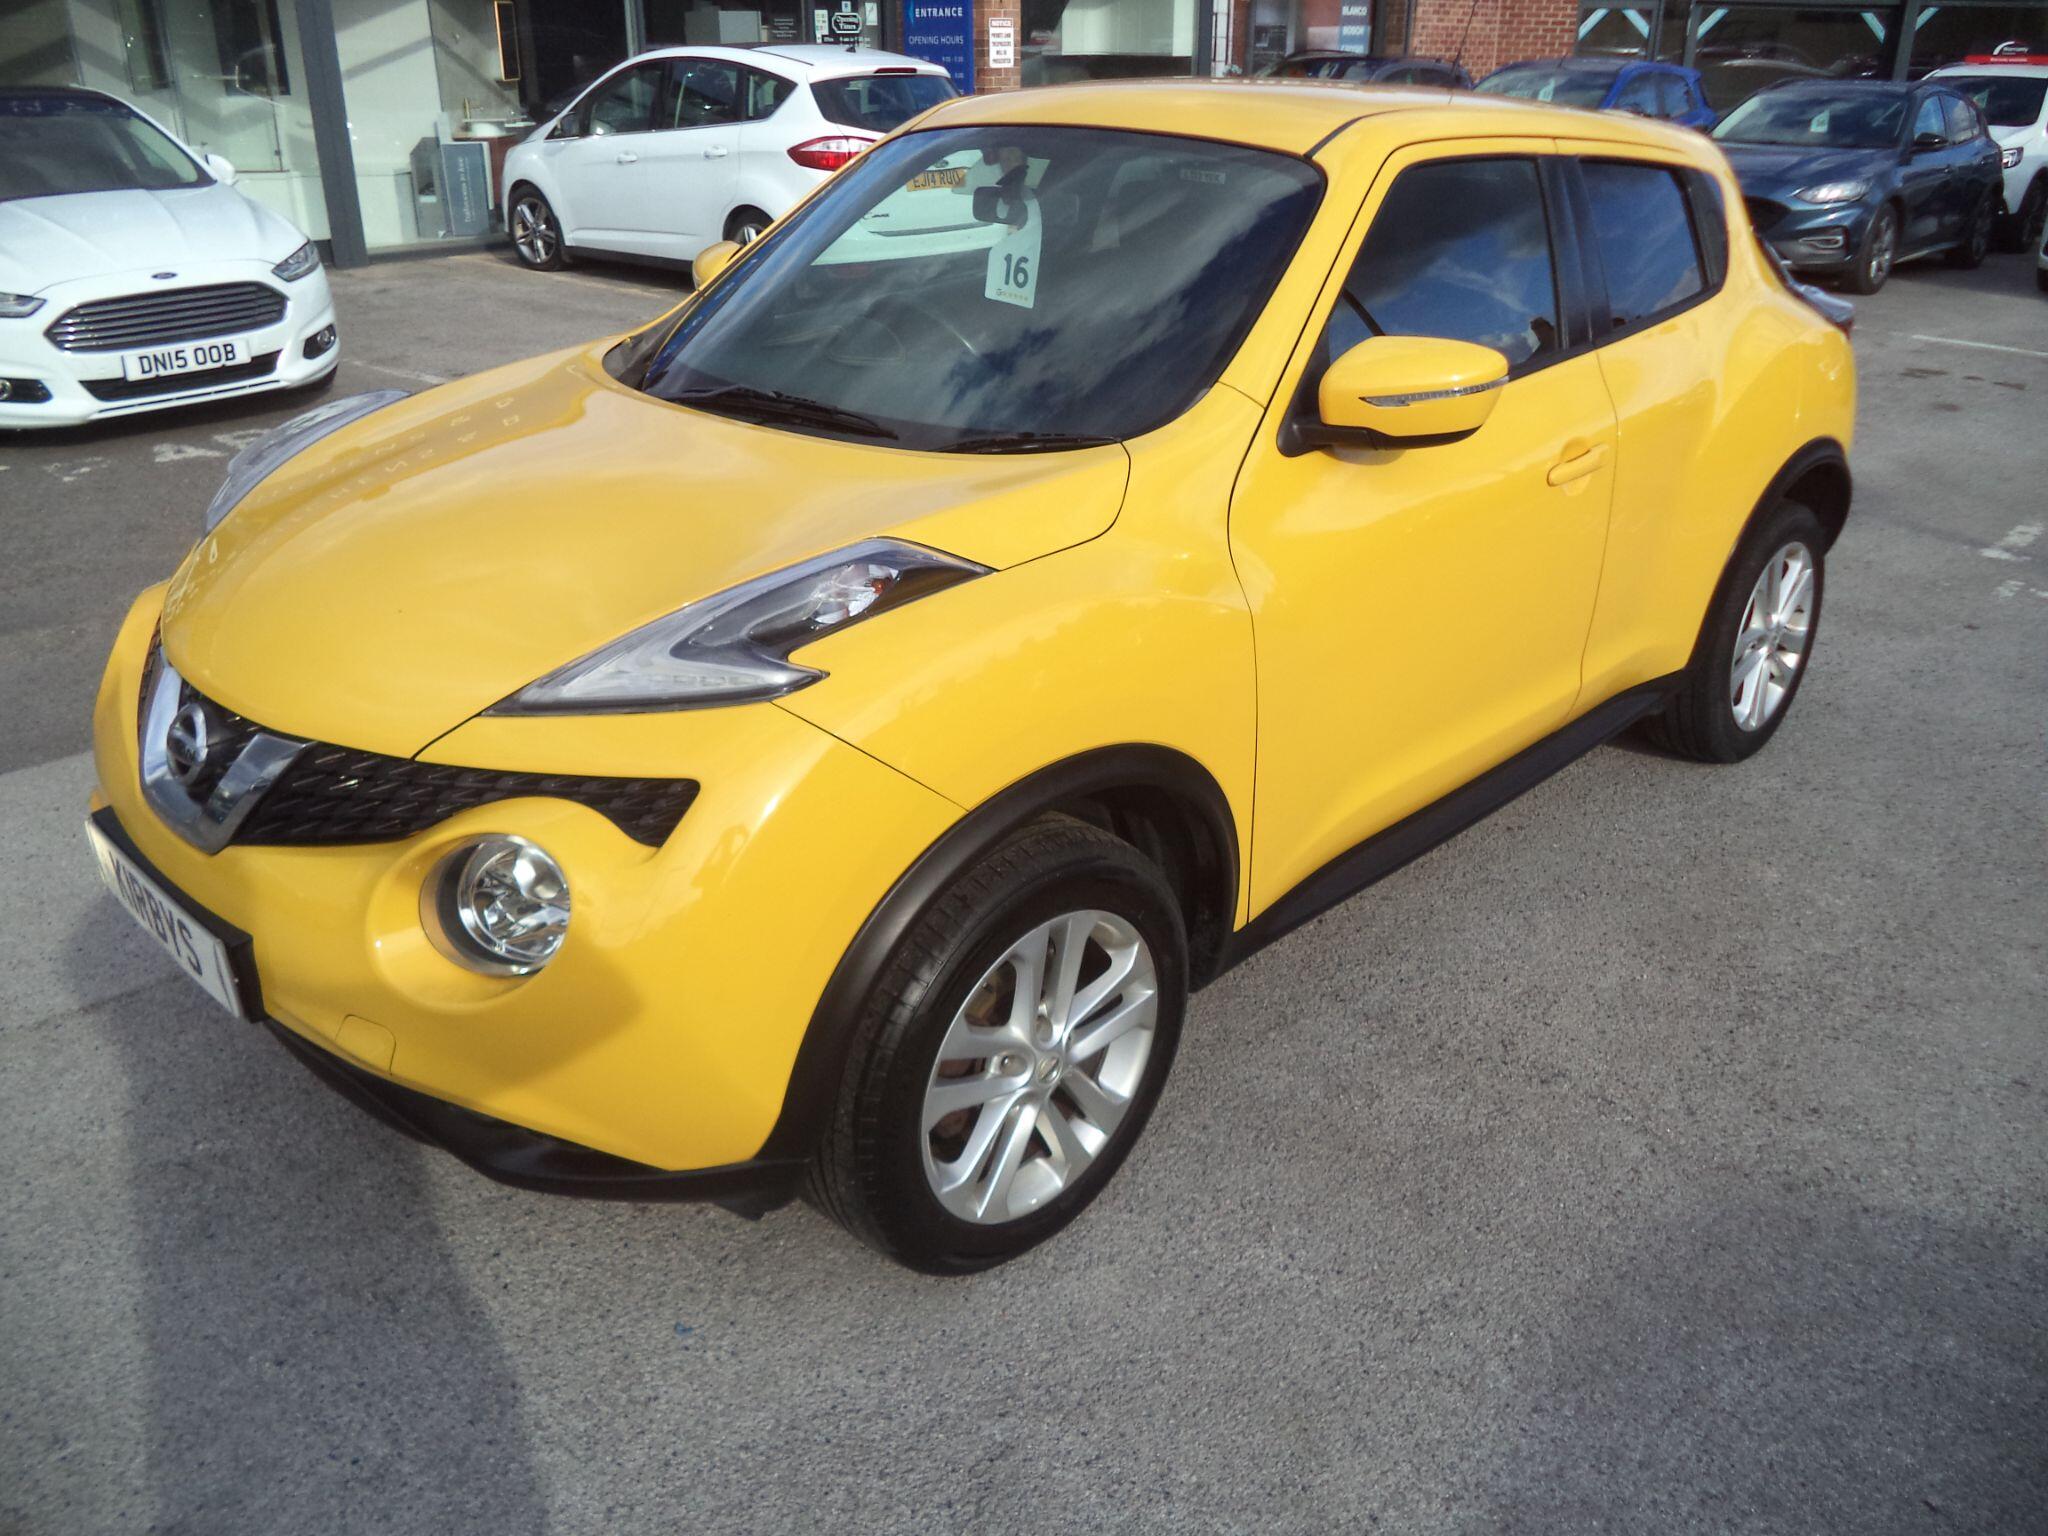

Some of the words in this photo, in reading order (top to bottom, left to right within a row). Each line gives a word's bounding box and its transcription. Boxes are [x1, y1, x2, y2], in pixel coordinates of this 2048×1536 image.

[915, 7, 963, 17] ENTRANCE
[908, 36, 939, 45] OPENING
[941, 36, 964, 45] HOURS
[1004, 253, 1029, 289] 16
[138, 350, 188, 375] DN15
[194, 343, 236, 366] OOB
[108, 851, 203, 977] KIRBYS
